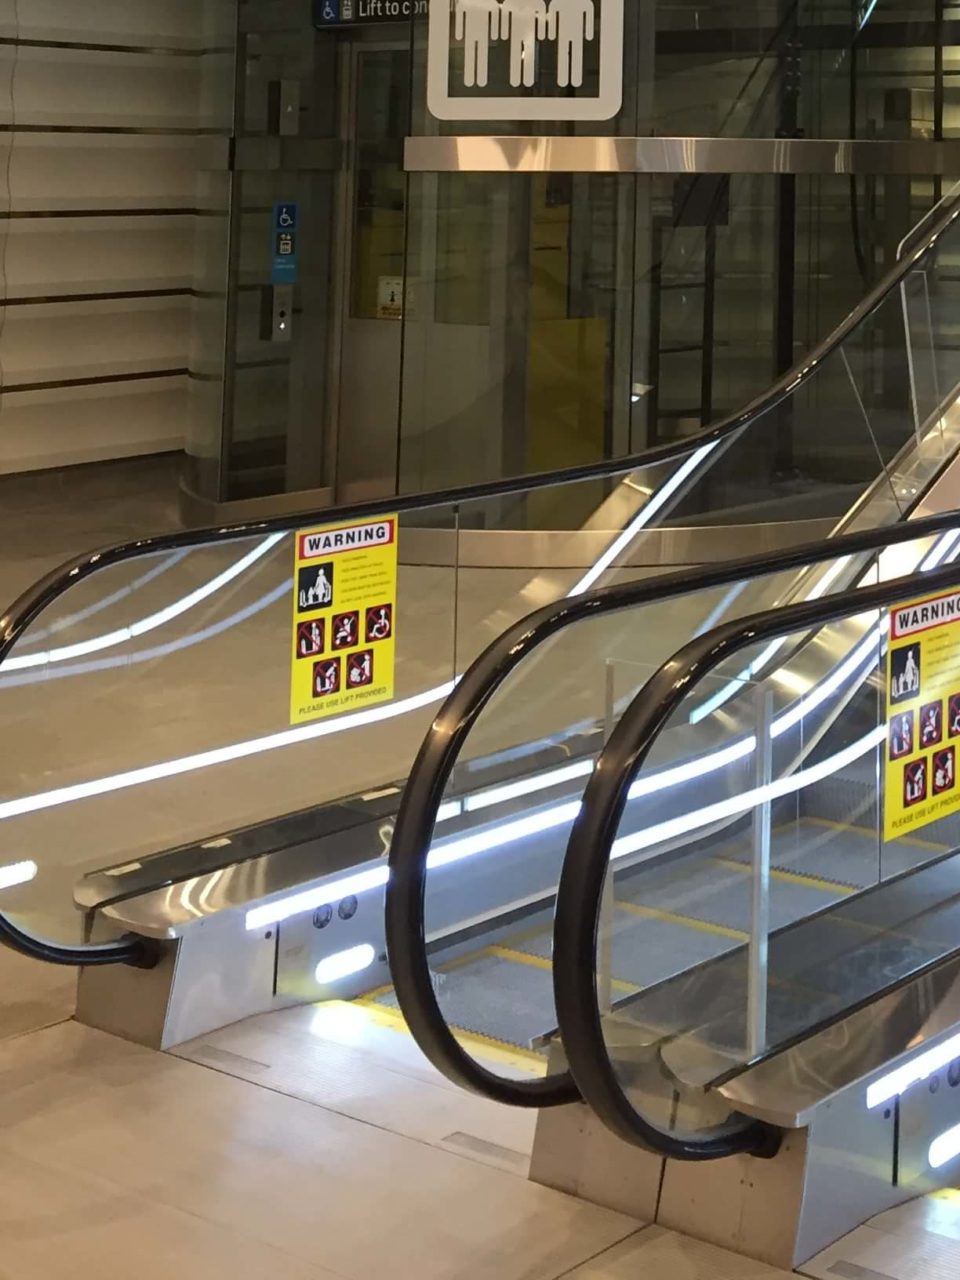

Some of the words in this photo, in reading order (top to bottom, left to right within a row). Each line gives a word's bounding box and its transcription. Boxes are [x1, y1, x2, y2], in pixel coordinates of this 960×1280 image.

[359, 0, 382, 17] Lift
[385, 0, 400, 16] to
[308, 526, 386, 552] WARNING
[299, 701, 324, 715] PLEASE
[326, 698, 340, 708] USE
[340, 695, 355, 705] LIFT
[355, 686, 387, 700] PROVIDED
[892, 812, 914, 829] PLEASE
[927, 802, 939, 815] LIFT
